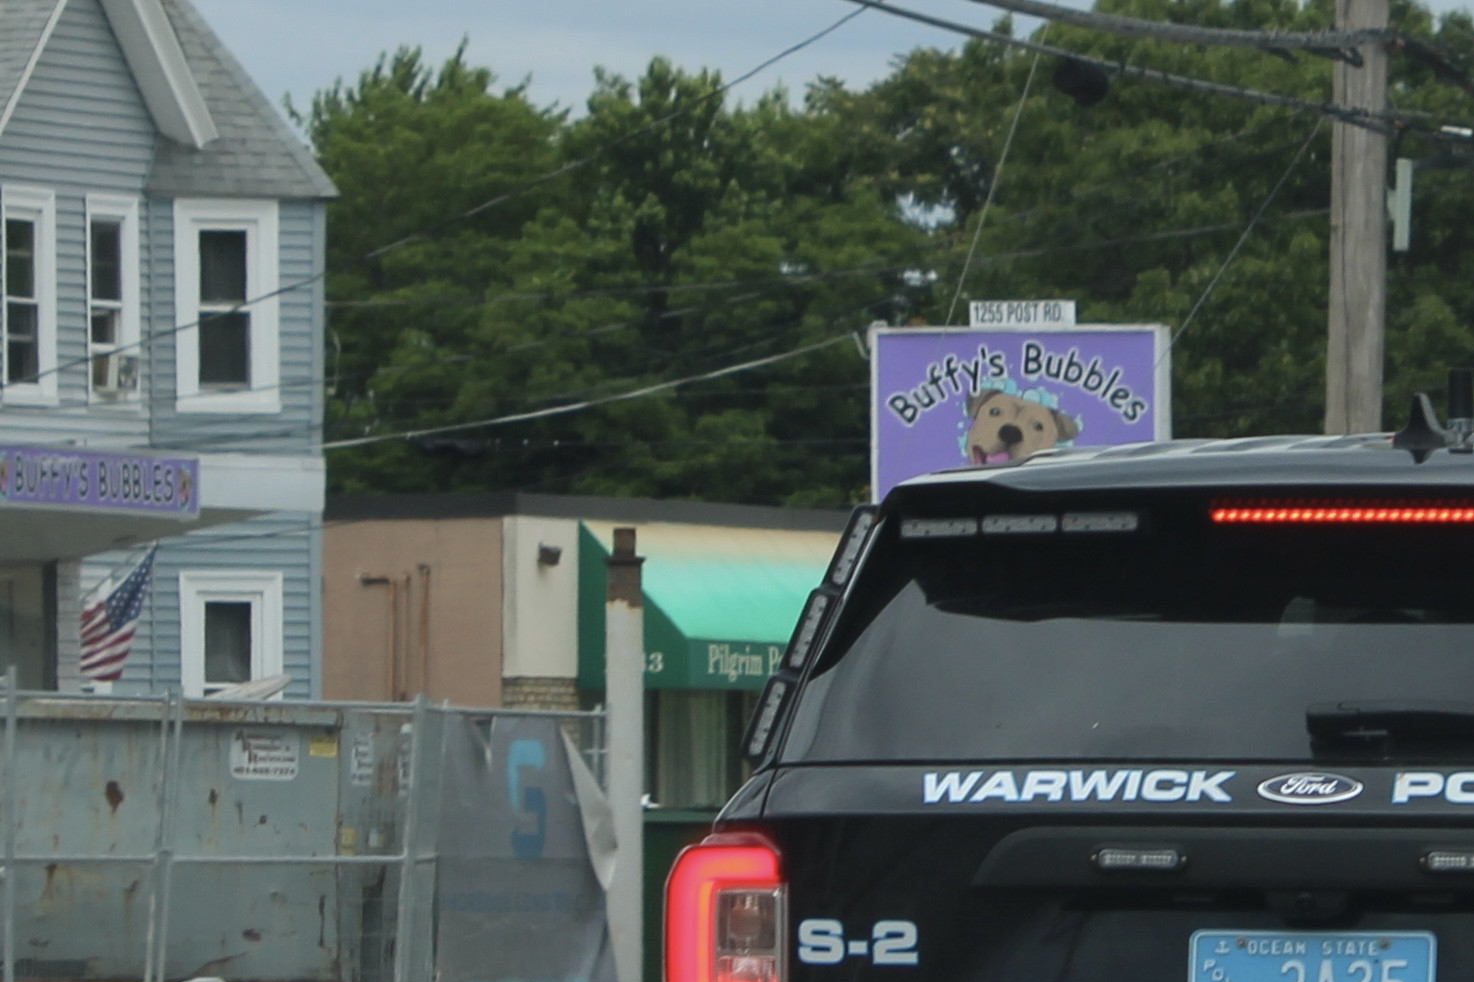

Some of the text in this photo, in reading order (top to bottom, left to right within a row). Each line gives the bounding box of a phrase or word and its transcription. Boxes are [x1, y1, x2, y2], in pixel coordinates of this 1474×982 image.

[974, 302, 1004, 323] 1255
[1006, 303, 1038, 322] POST
[887, 343, 1145, 423] Buffy's Bubbles
[15, 454, 174, 501] BUFFY'S BUBBLES
[707, 643, 784, 682] Pilgrim P
[923, 769, 1237, 803] WARWICK
[797, 918, 919, 965] S-2
[1246, 940, 1380, 956] OCEAN STATE
